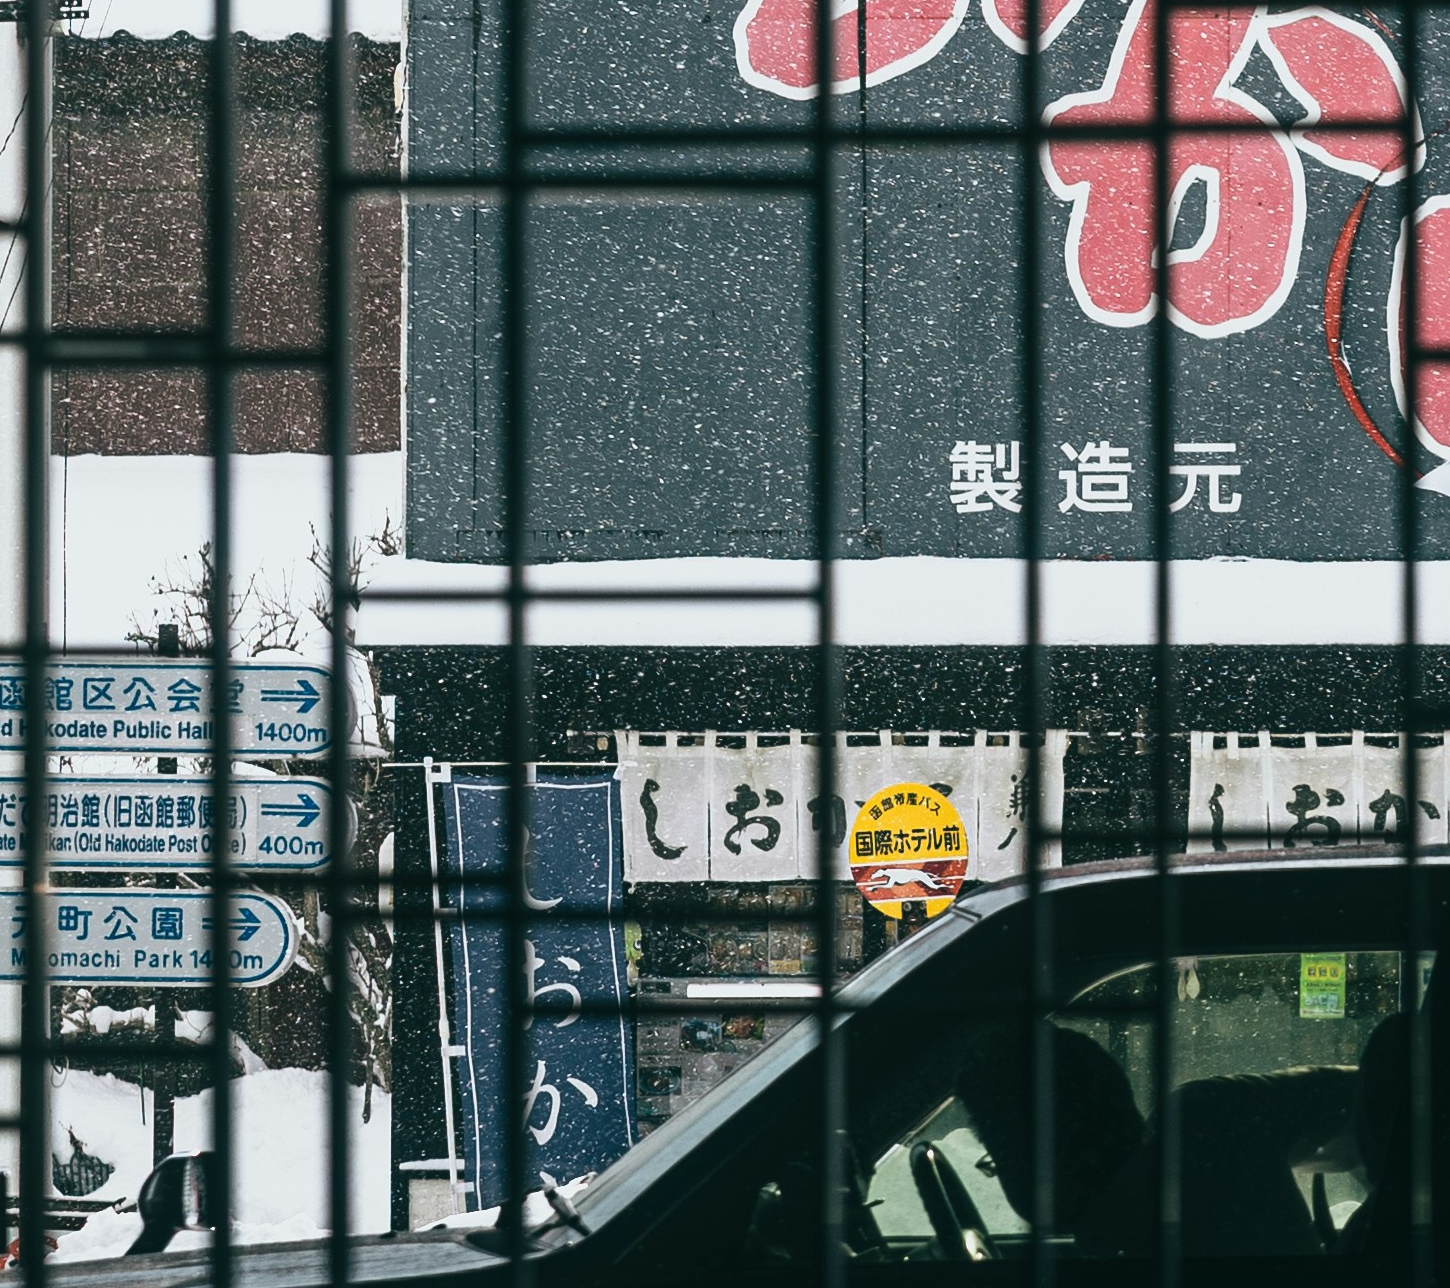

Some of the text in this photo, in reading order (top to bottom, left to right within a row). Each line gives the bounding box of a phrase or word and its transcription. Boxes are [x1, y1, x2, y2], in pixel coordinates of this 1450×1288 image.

[950, 440, 1243, 513] 製造元
[19, 717, 108, 739] kodate
[113, 718, 174, 739] Public
[178, 719, 214, 739] Hall
[255, 722, 327, 743] 1400m
[640, 778, 954, 860] しおか
[19, 832, 72, 853] Mikan
[74, 832, 101, 855] (Old
[105, 832, 166, 852] Hakodate
[168, 833, 198, 853] Post
[259, 836, 324, 855] 400m
[855, 824, 960, 857] 国際ホテル前
[11, 950, 263, 970] Momachi Park 140m
